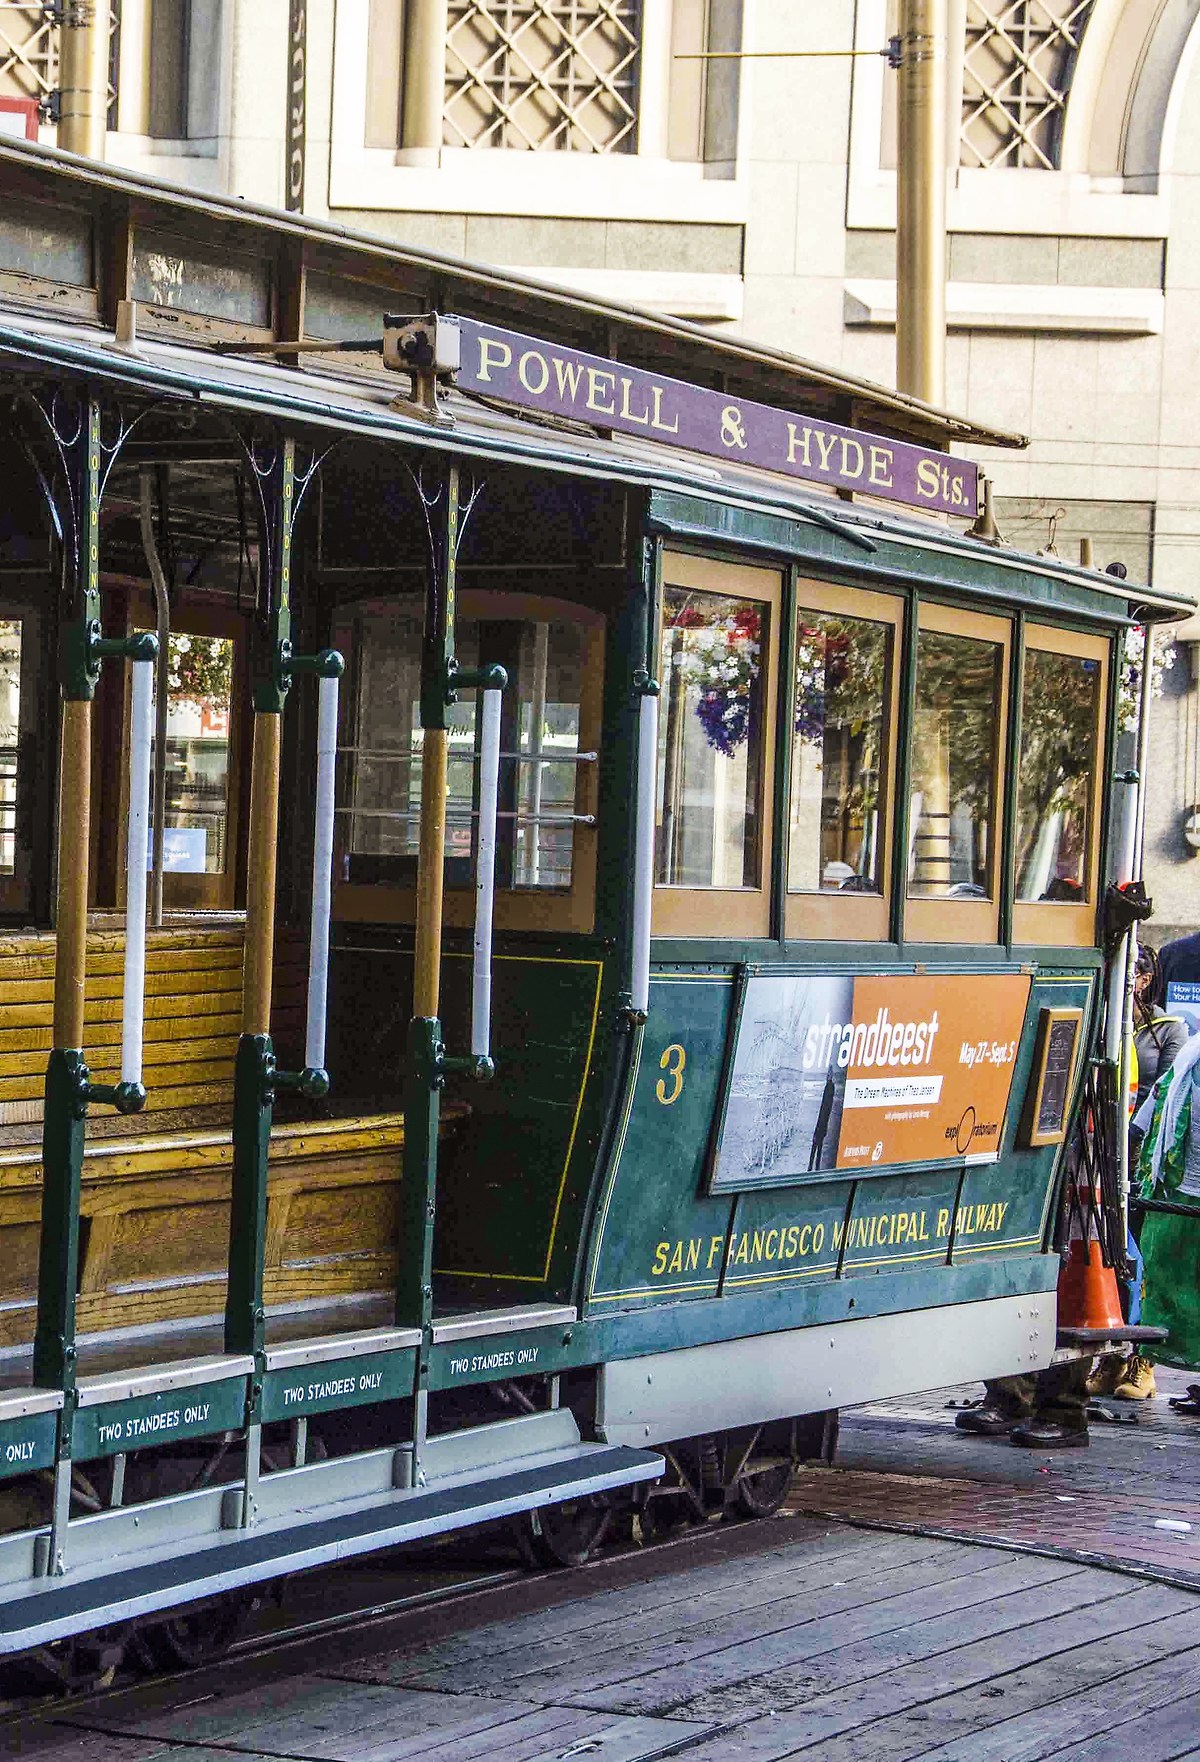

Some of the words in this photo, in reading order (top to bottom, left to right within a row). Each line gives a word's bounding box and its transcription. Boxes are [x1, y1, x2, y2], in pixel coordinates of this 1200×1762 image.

[476, 337, 679, 434] POWELL
[720, 406, 749, 450] &
[786, 422, 894, 488] HYDE
[916, 458, 970, 506] Sts.
[802, 1008, 939, 1069] strandbeest
[958, 1042, 977, 1069] May
[656, 1044, 686, 1105] 3
[651, 1238, 702, 1275] SAN
[830, 1211, 930, 1252] MUNICIPAL
[936, 1202, 1009, 1239] RAILWAY
[450, 1357, 469, 1375] TWO
[472, 1350, 514, 1371] STANDEES
[517, 1347, 539, 1365] ONLY
[283, 1386, 304, 1405] TWO
[307, 1375, 356, 1401] STANDEES
[359, 1372, 383, 1390] ONLY
[99, 1423, 122, 1443] TWO
[126, 1410, 179, 1437] STANDEES
[184, 1404, 210, 1423] ONLY
[6, 1442, 36, 1462] ONLY
